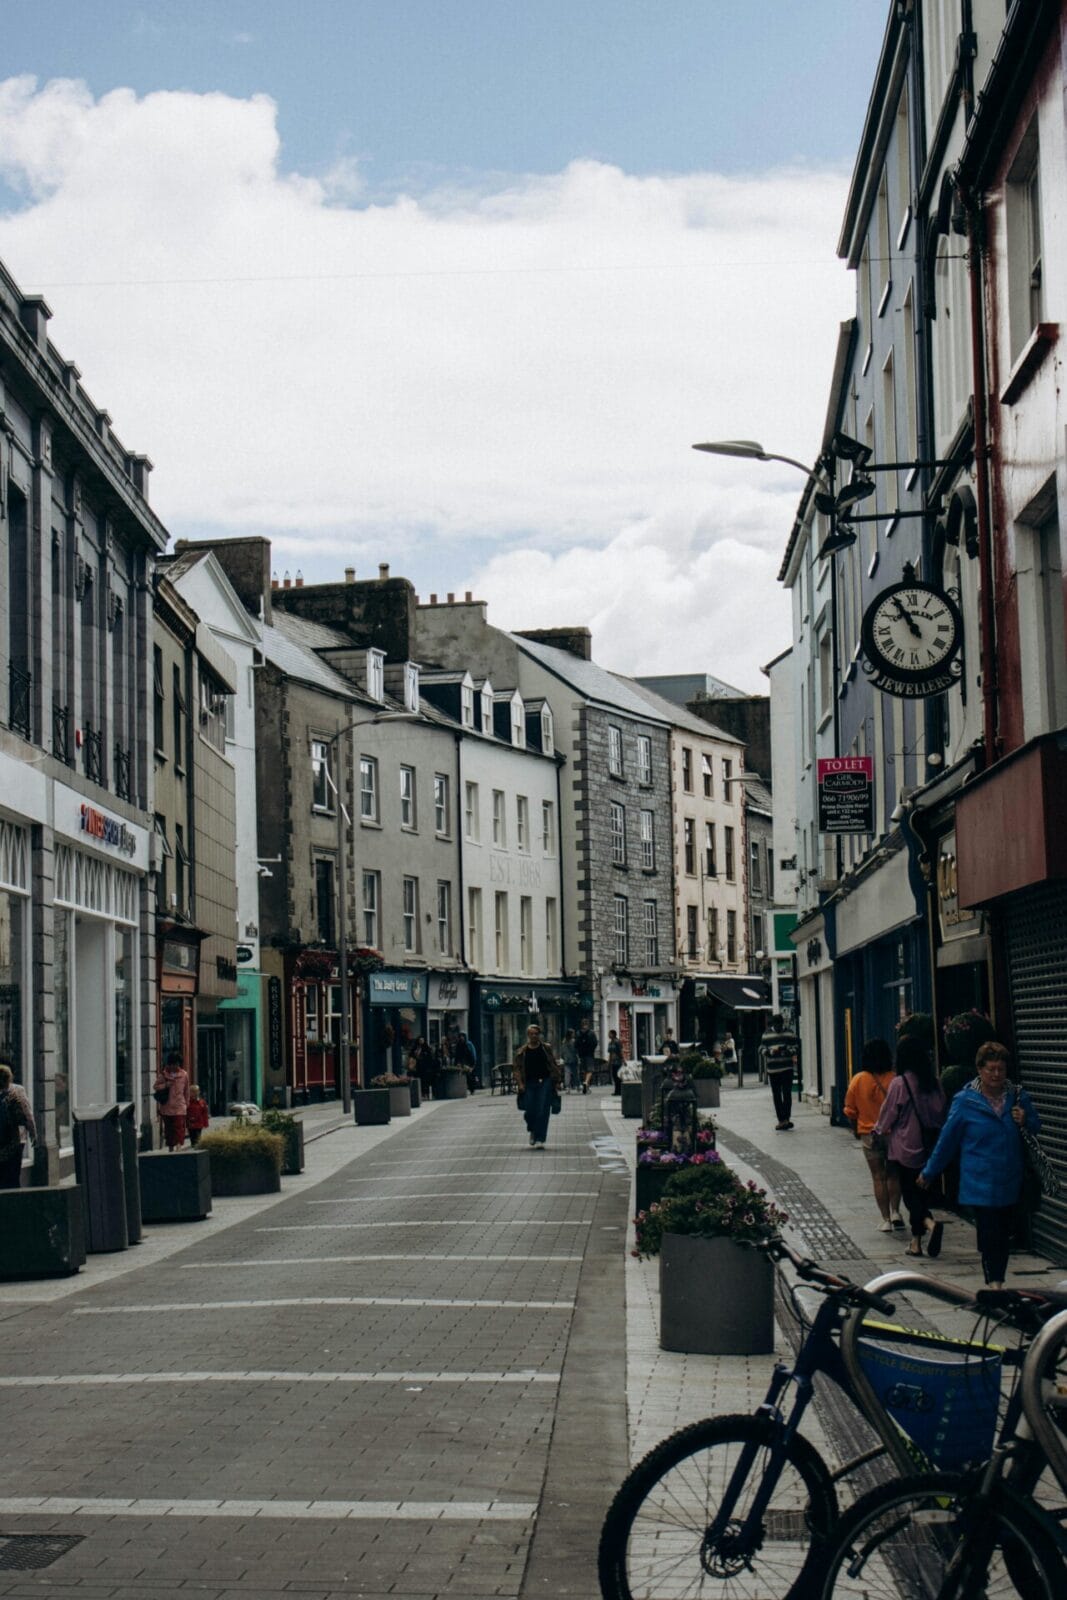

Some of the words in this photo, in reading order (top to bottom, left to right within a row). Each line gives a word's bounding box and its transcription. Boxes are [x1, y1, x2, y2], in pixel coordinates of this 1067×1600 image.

[877, 674, 952, 695] JEWELLERS
[825, 761, 841, 770] TO
[846, 760, 864, 769] LET
